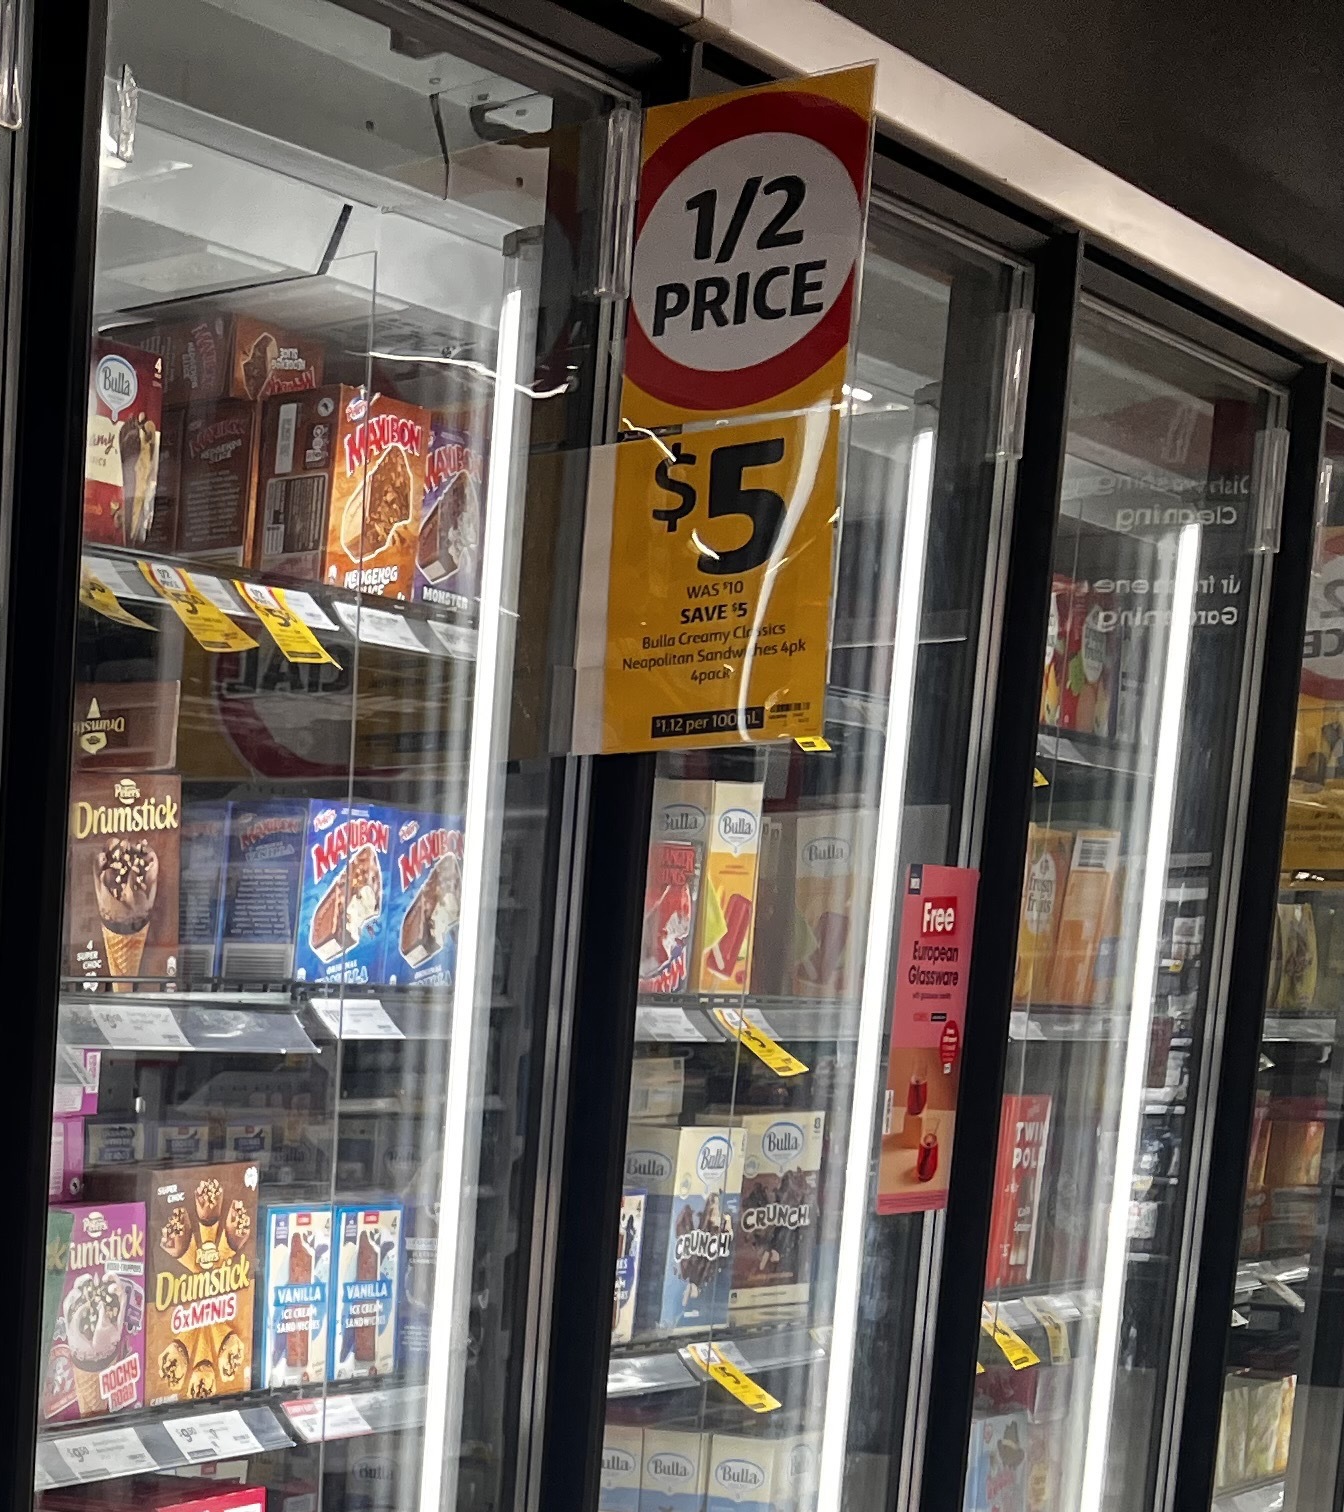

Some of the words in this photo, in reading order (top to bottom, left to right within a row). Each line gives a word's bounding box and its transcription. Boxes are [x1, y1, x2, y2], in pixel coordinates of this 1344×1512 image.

[685, 174, 807, 264] 1/2
[652, 259, 829, 338] PRICE
[103, 371, 132, 395] Bulla
[650, 437, 787, 575] $5
[686, 580, 720, 600] WAS
[722, 578, 744, 597] $10
[679, 605, 727, 625] SAVE
[731, 600, 748, 619] $5
[641, 632, 675, 650] Bulla
[678, 628, 731, 648] Creamy
[733, 621, 787, 642] Classics
[621, 650, 694, 674] Neapolitan
[697, 642, 778, 665] Sandwiches
[779, 637, 807, 657] 4pk
[690, 665, 733, 684] 4pack
[722, 814, 755, 838] Bulla
[923, 901, 956, 933] Free
[913, 941, 960, 966] European
[909, 964, 960, 987] Glassware
[767, 1133, 800, 1154] Bulla
[156, 1254, 250, 1313] Drumstick
[277, 1286, 321, 1305] VANILLA
[654, 1460, 689, 1479] Bulla
